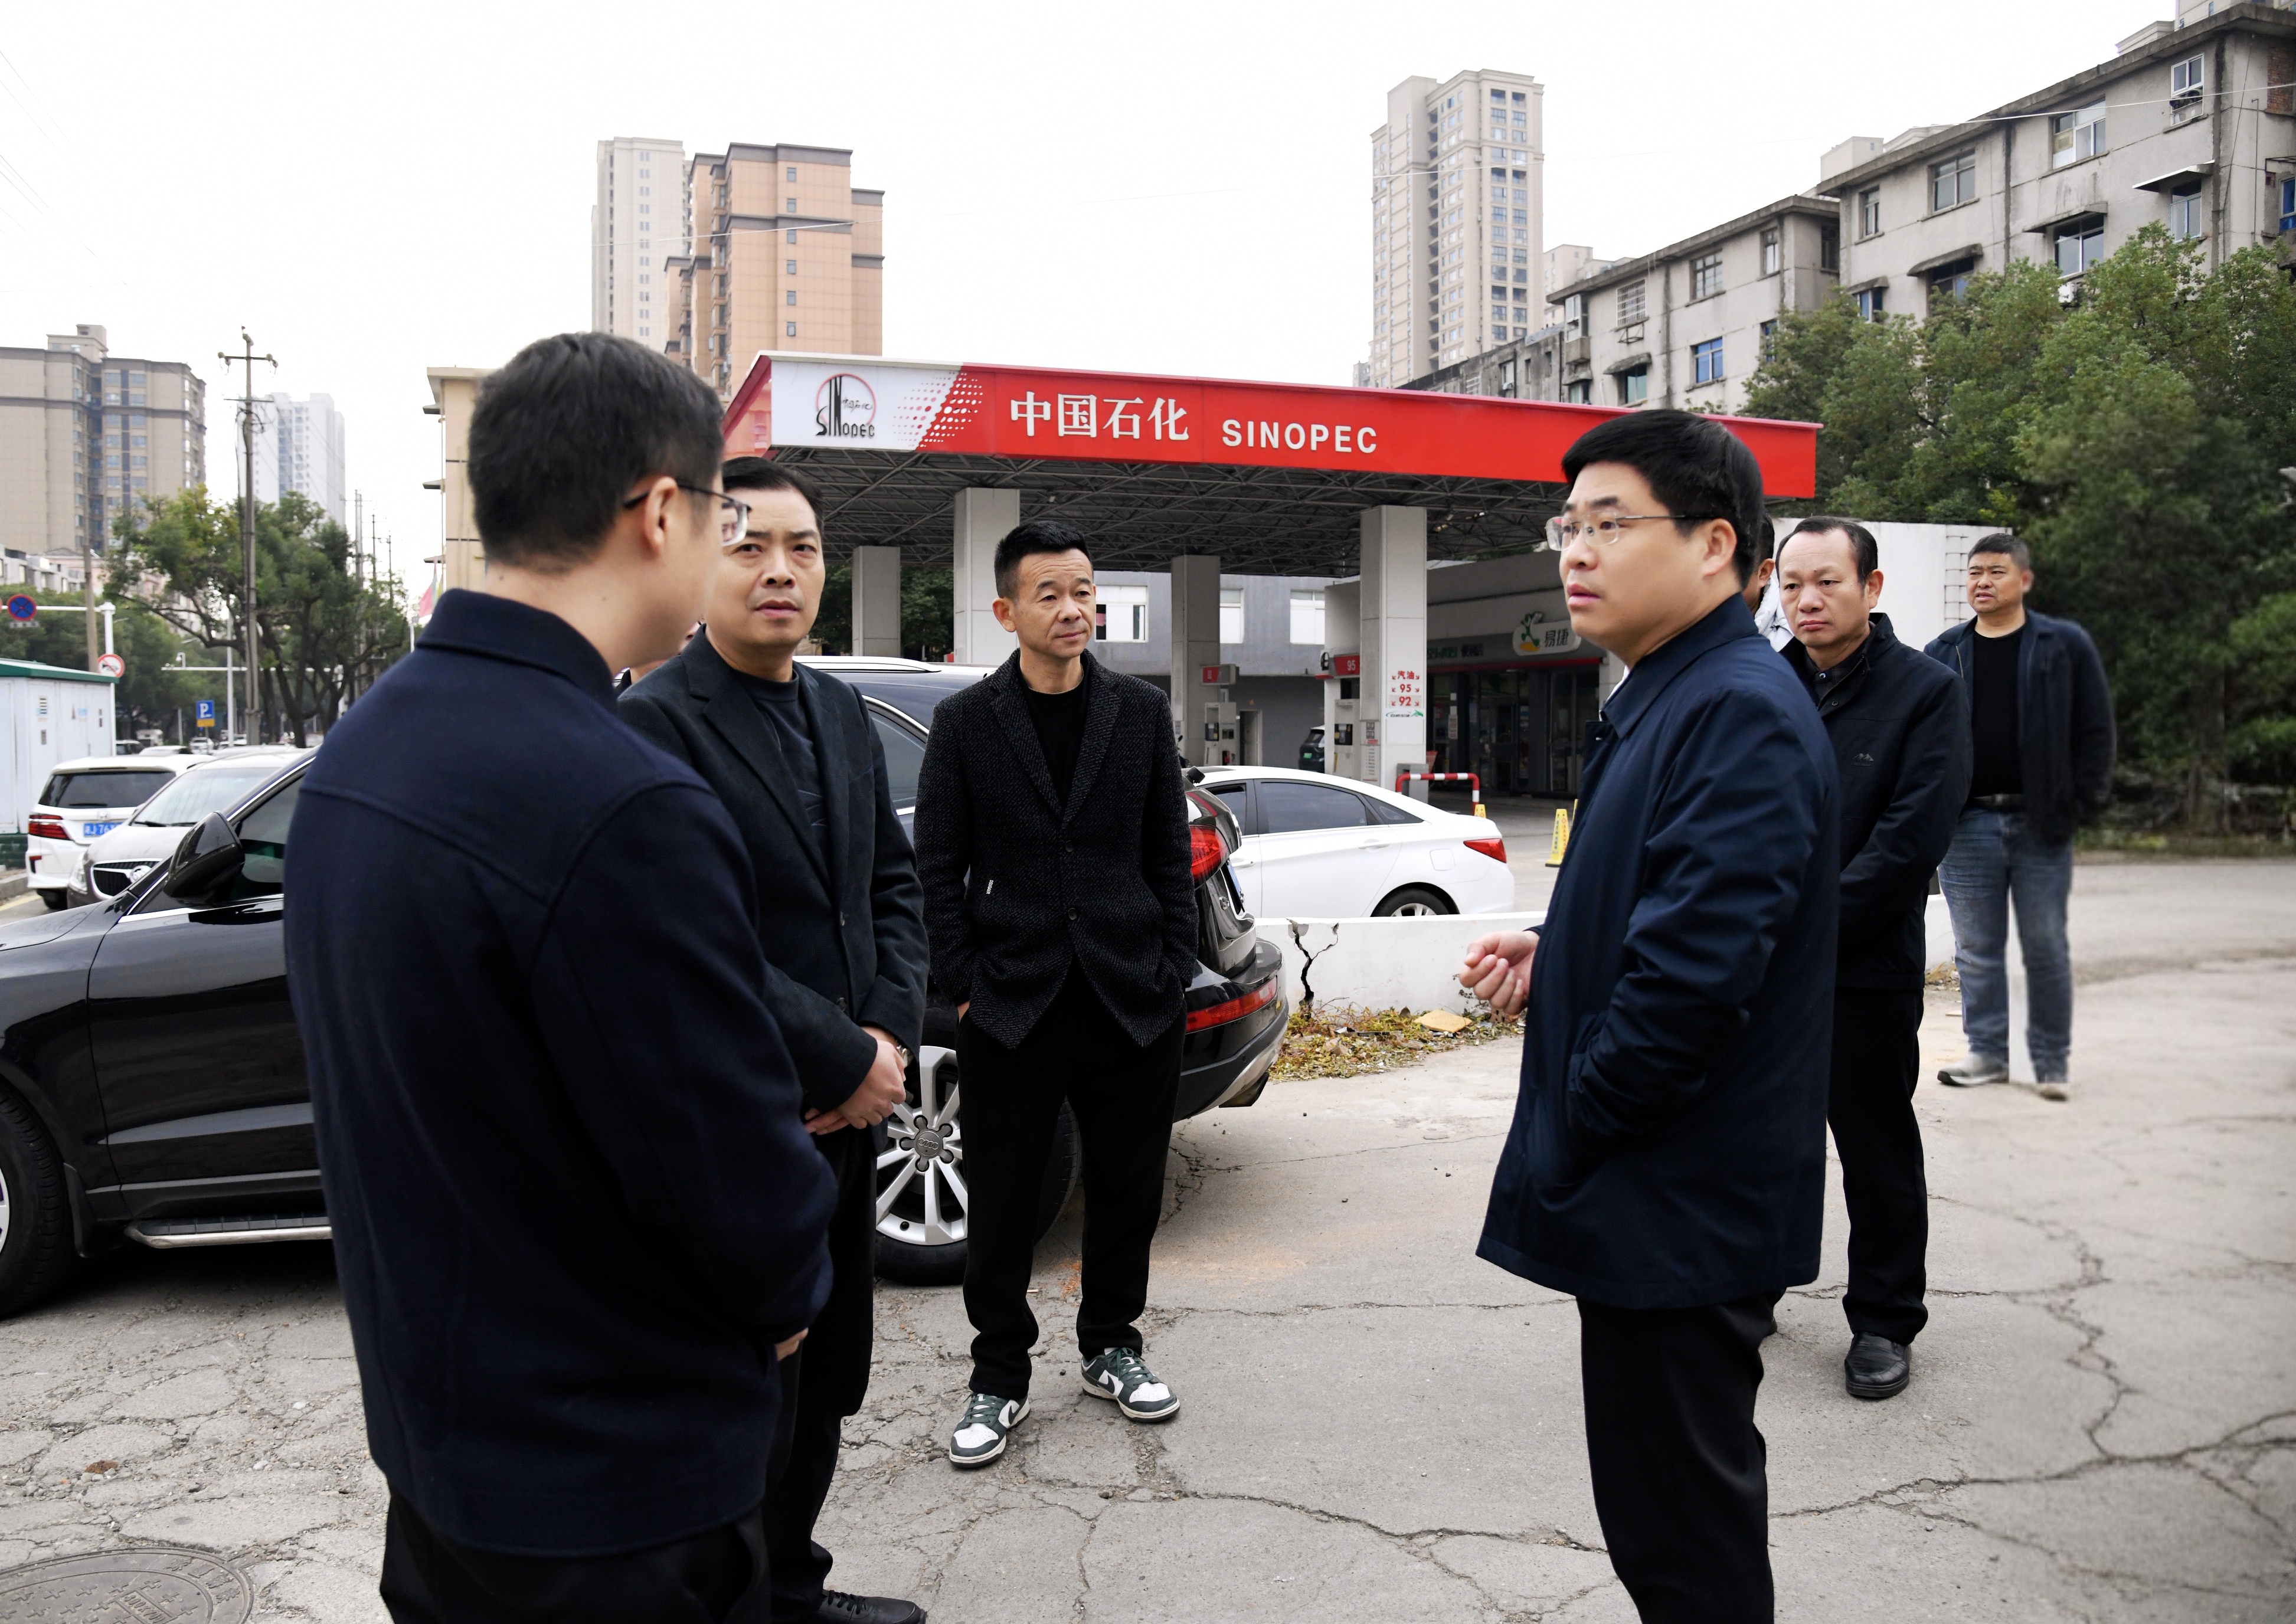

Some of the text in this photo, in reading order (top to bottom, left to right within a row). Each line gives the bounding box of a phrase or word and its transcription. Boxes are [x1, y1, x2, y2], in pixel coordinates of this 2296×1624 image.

[815, 375, 875, 438] SINOPEC
[1010, 391, 1190, 441] 中国石化
[1222, 418, 1376, 454] SINOPEC
[1544, 628, 1569, 648] 易捷
[1347, 660, 1356, 671] 95
[1397, 670, 1415, 680] 汽油
[1399, 683, 1411, 693] 95
[1399, 696, 1411, 706] 92
